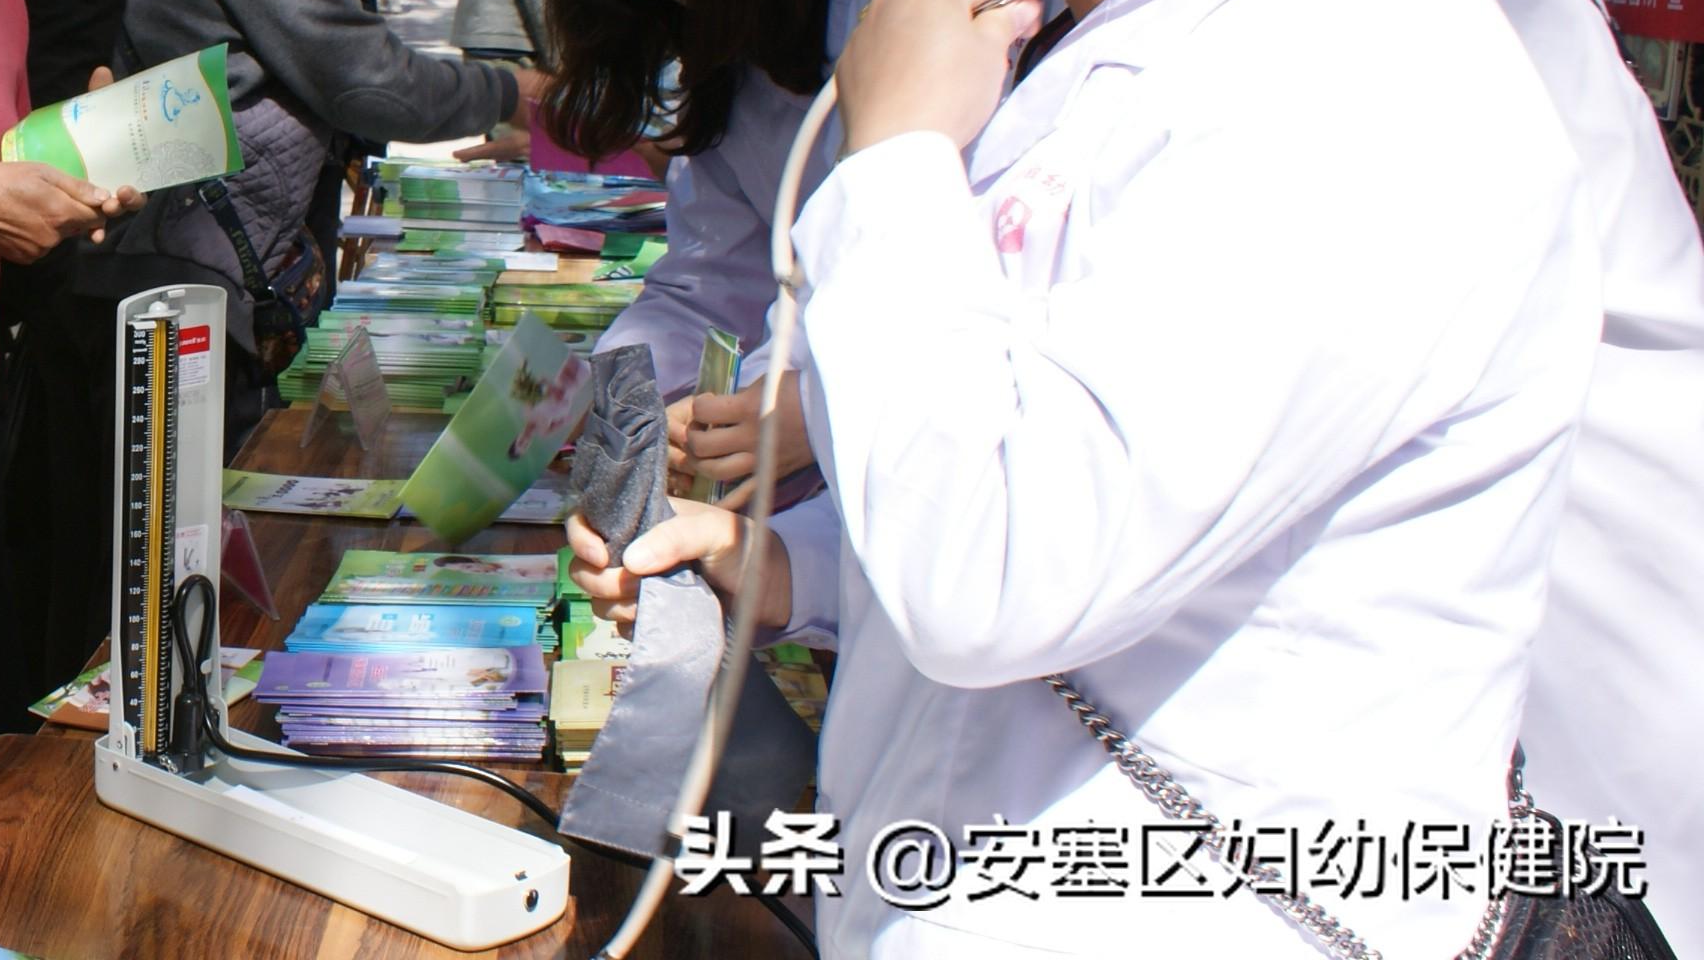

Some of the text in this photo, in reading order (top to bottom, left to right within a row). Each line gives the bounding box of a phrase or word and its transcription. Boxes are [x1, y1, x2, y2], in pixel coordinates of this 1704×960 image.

[133, 357, 145, 365] 280
[132, 386, 145, 394] 260
[131, 415, 144, 423] 240
[131, 444, 144, 452] 220
[130, 473, 143, 481] 200
[129, 559, 141, 567] 140
[129, 587, 140, 595] 120
[128, 615, 140, 623] 100
[130, 643, 139, 651] 80
[130, 671, 139, 679] 60
[129, 698, 138, 707] 40
